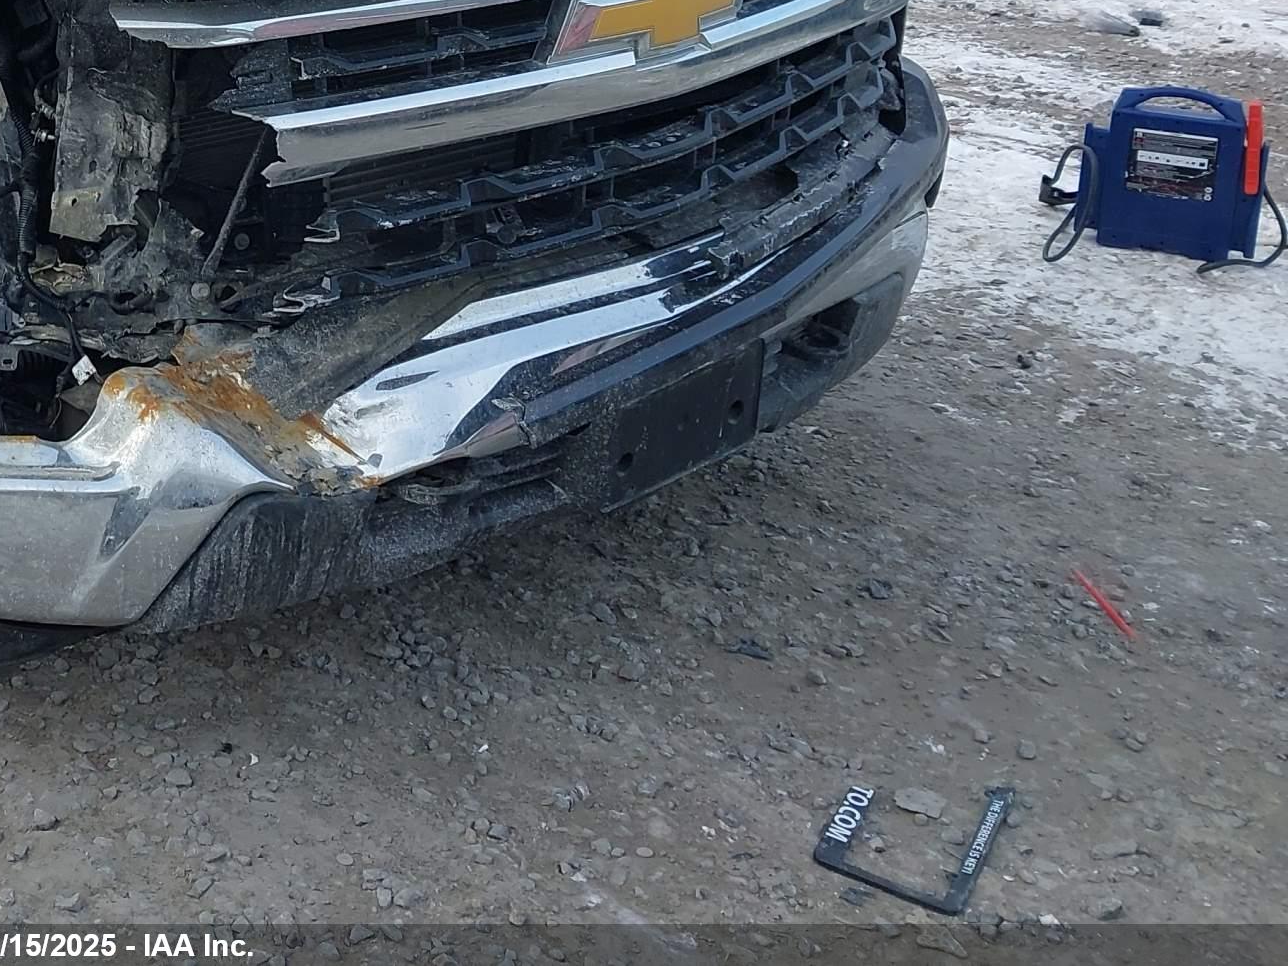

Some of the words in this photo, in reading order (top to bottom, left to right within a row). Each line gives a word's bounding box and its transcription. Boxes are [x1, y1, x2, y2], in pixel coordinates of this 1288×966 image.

[824, 785, 875, 843] TO.COM
[989, 799, 1005, 813] THE
[972, 812, 999, 852] DIFFERENCE
[968, 849, 981, 860] IS
